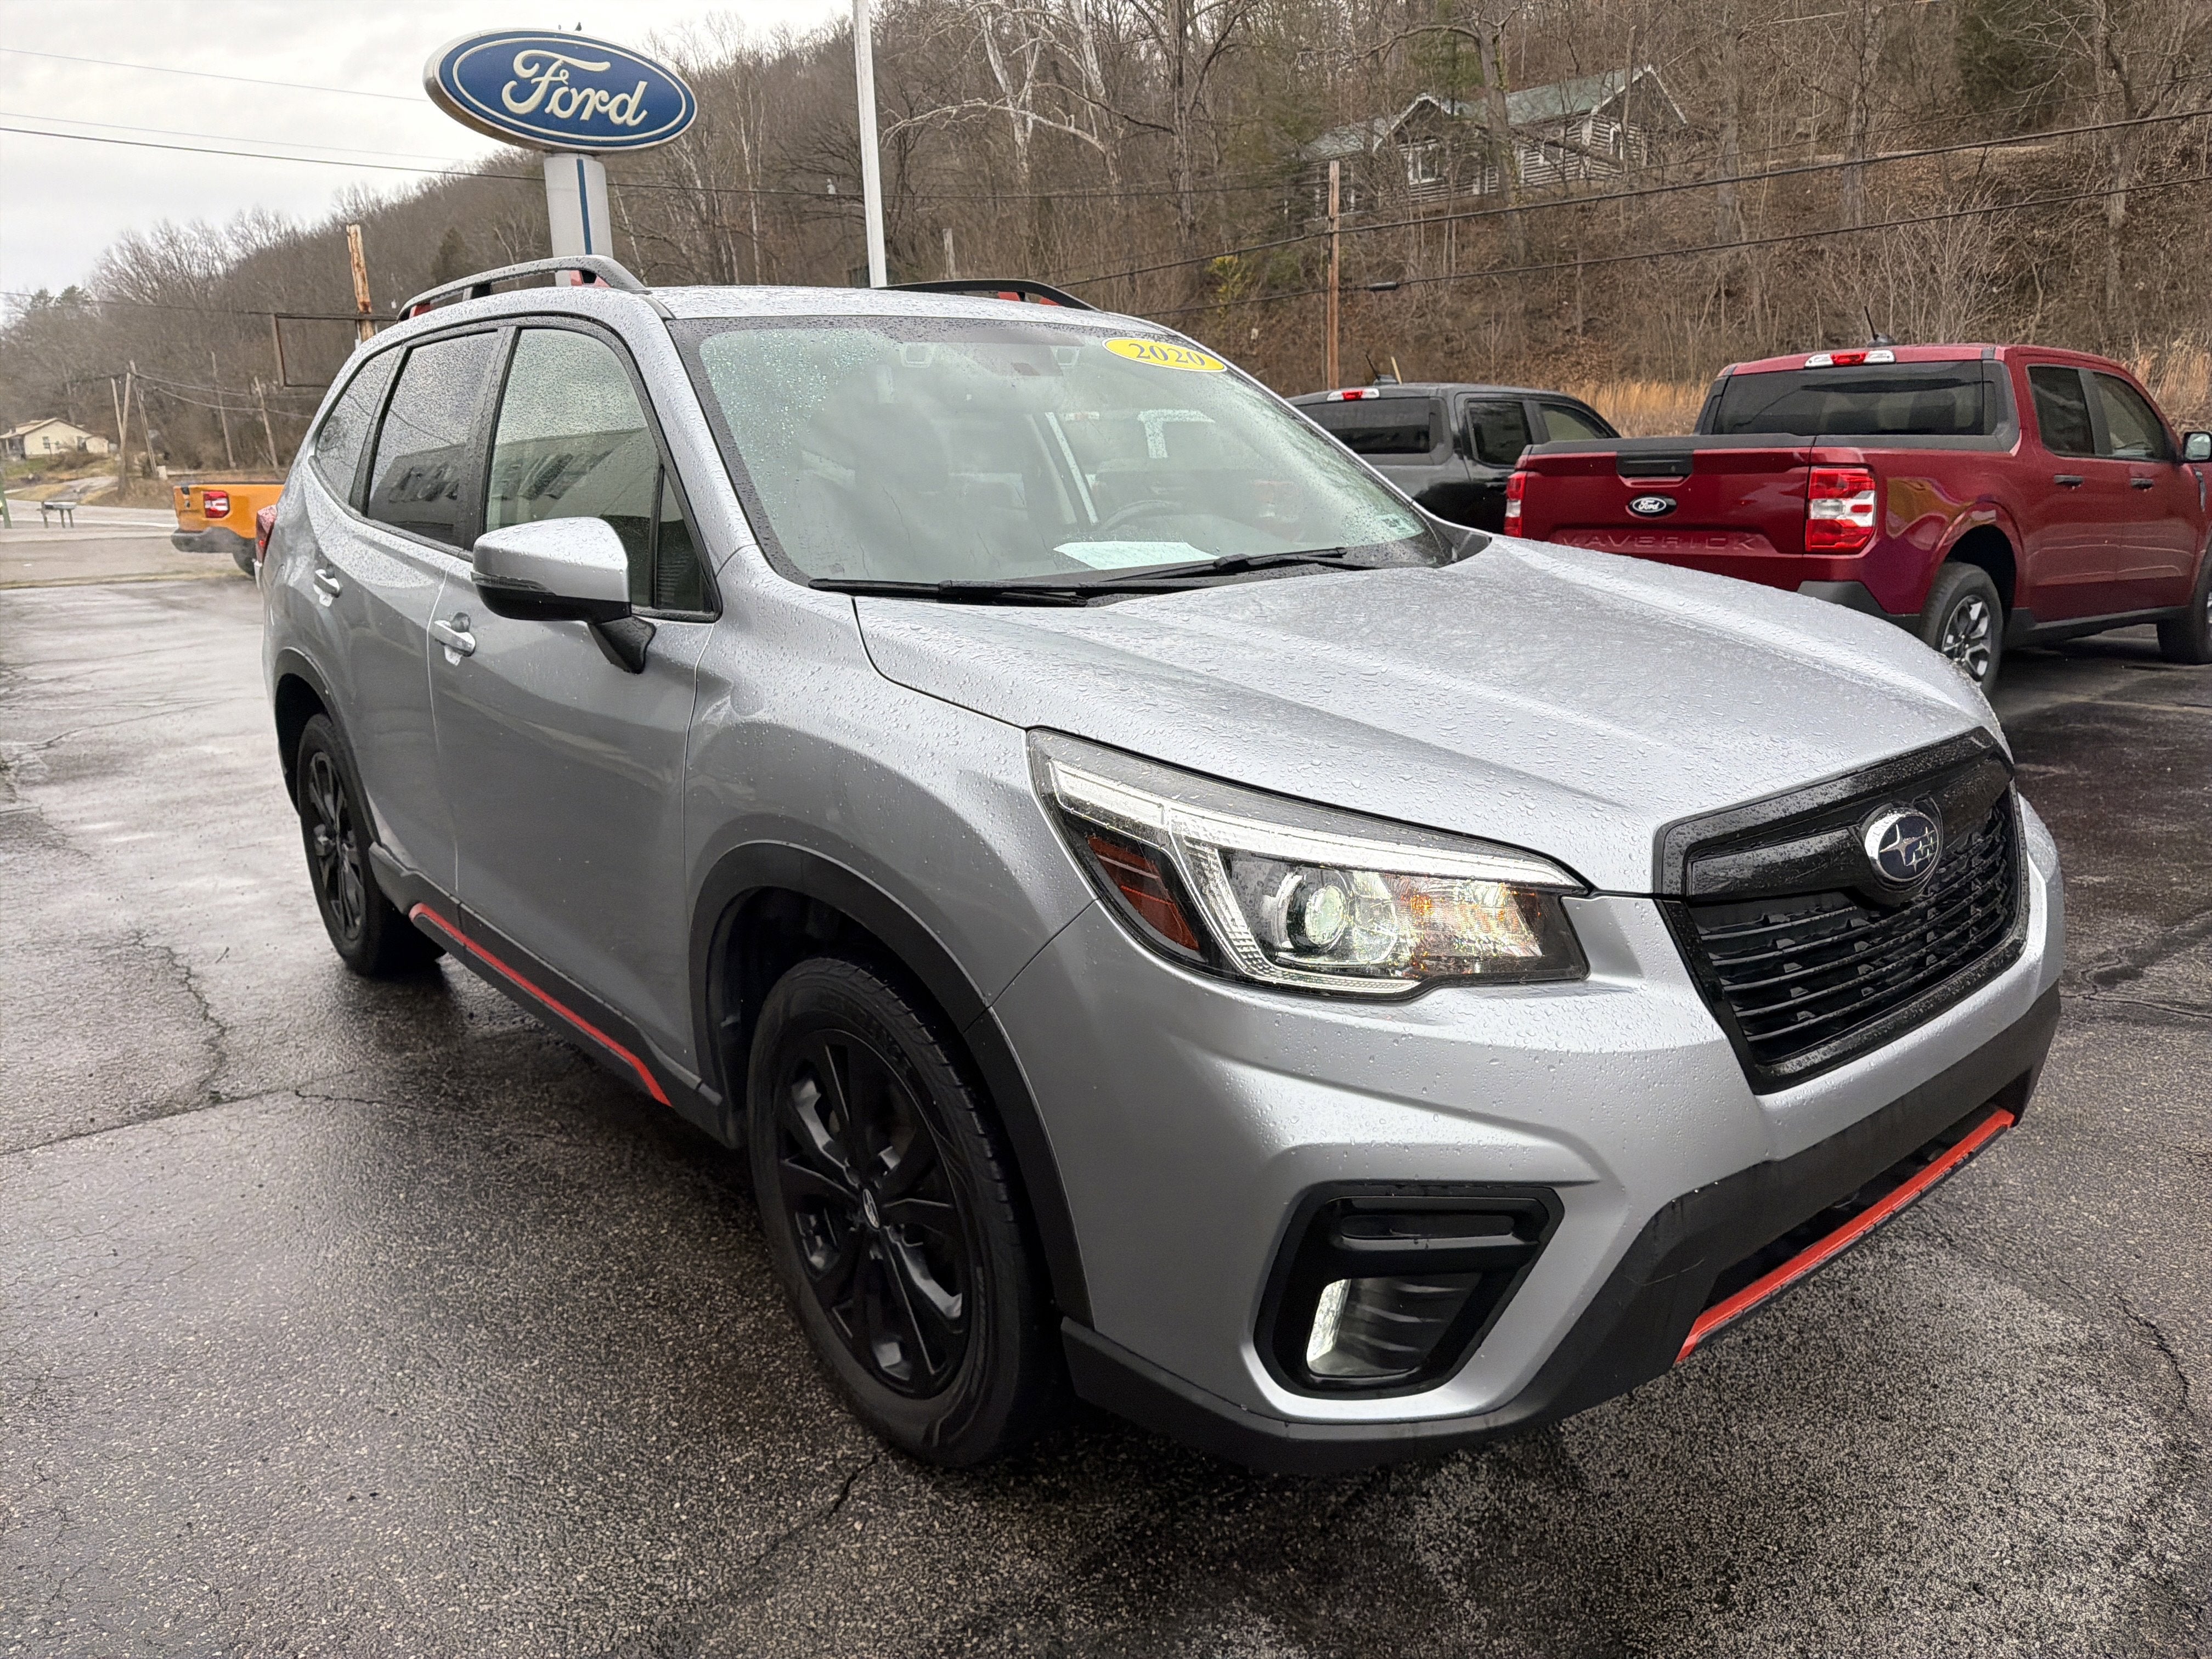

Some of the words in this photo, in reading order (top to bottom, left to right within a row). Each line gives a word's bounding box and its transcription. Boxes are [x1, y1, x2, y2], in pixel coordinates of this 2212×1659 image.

[501, 49, 647, 127] Ford
[1128, 343, 1205, 366] 2020
[1638, 500, 1660, 510] Ford
[1559, 533, 1755, 550] MAVERICK
